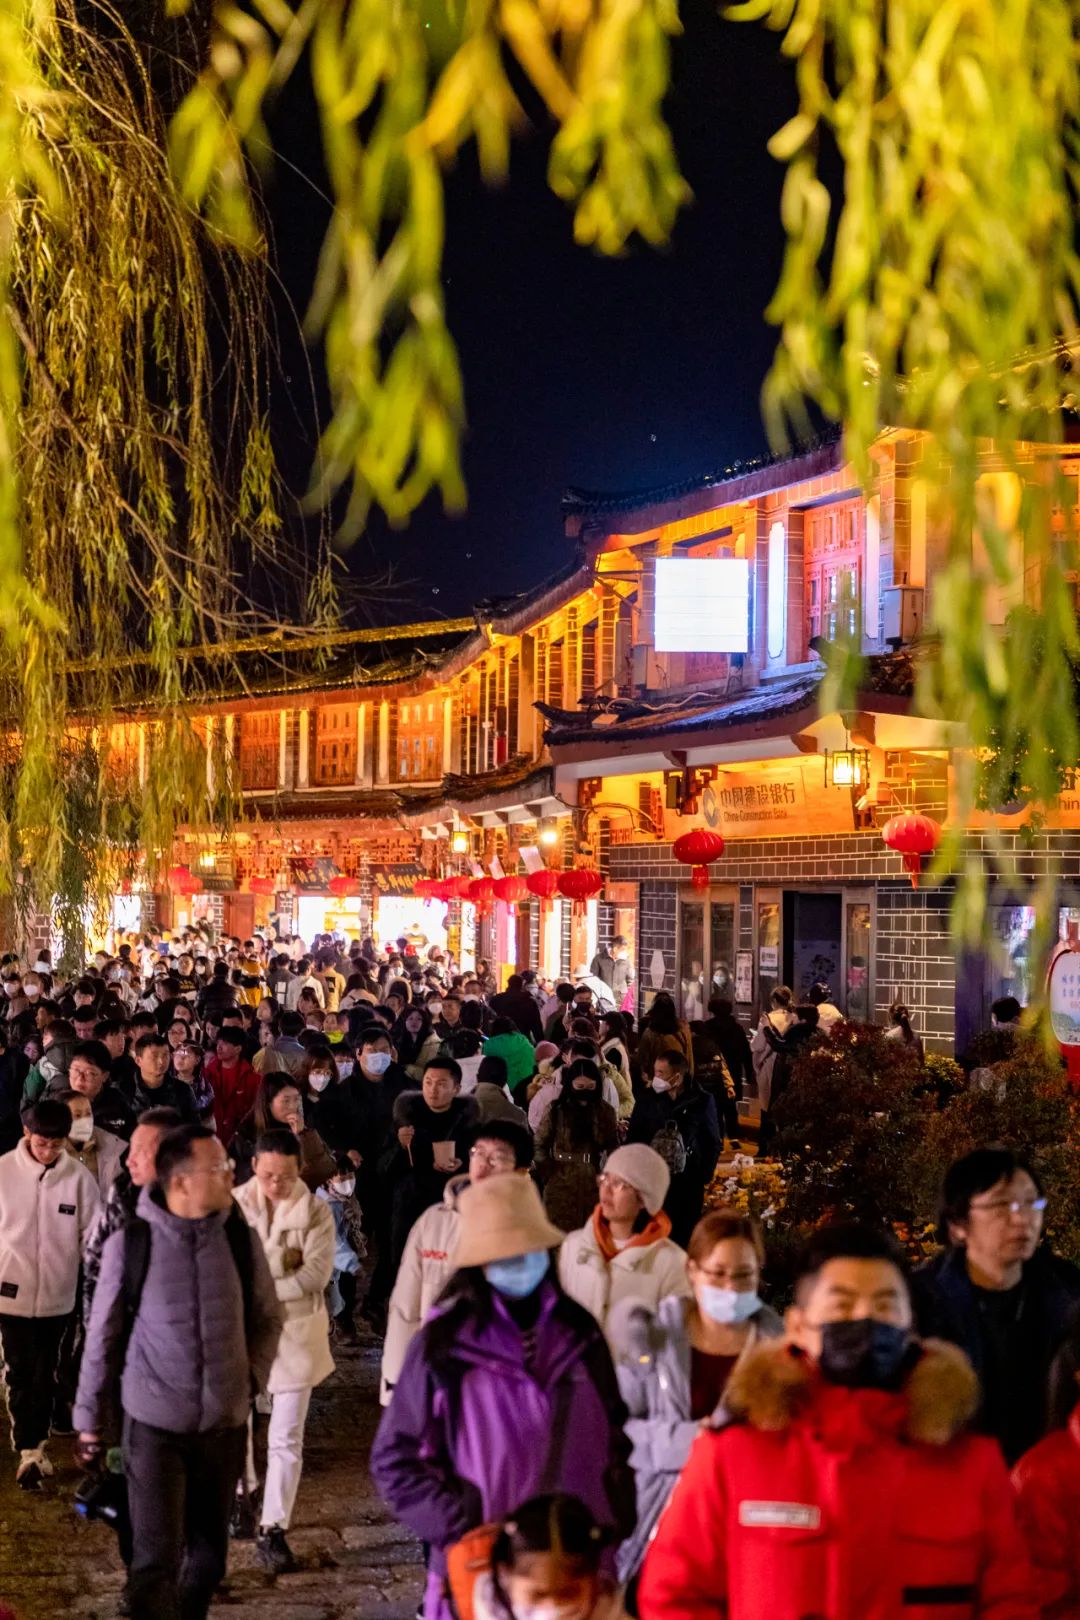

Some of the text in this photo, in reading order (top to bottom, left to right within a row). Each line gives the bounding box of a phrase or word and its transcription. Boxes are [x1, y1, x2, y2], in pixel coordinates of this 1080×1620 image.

[720, 783, 796, 808] 中国建设银行
